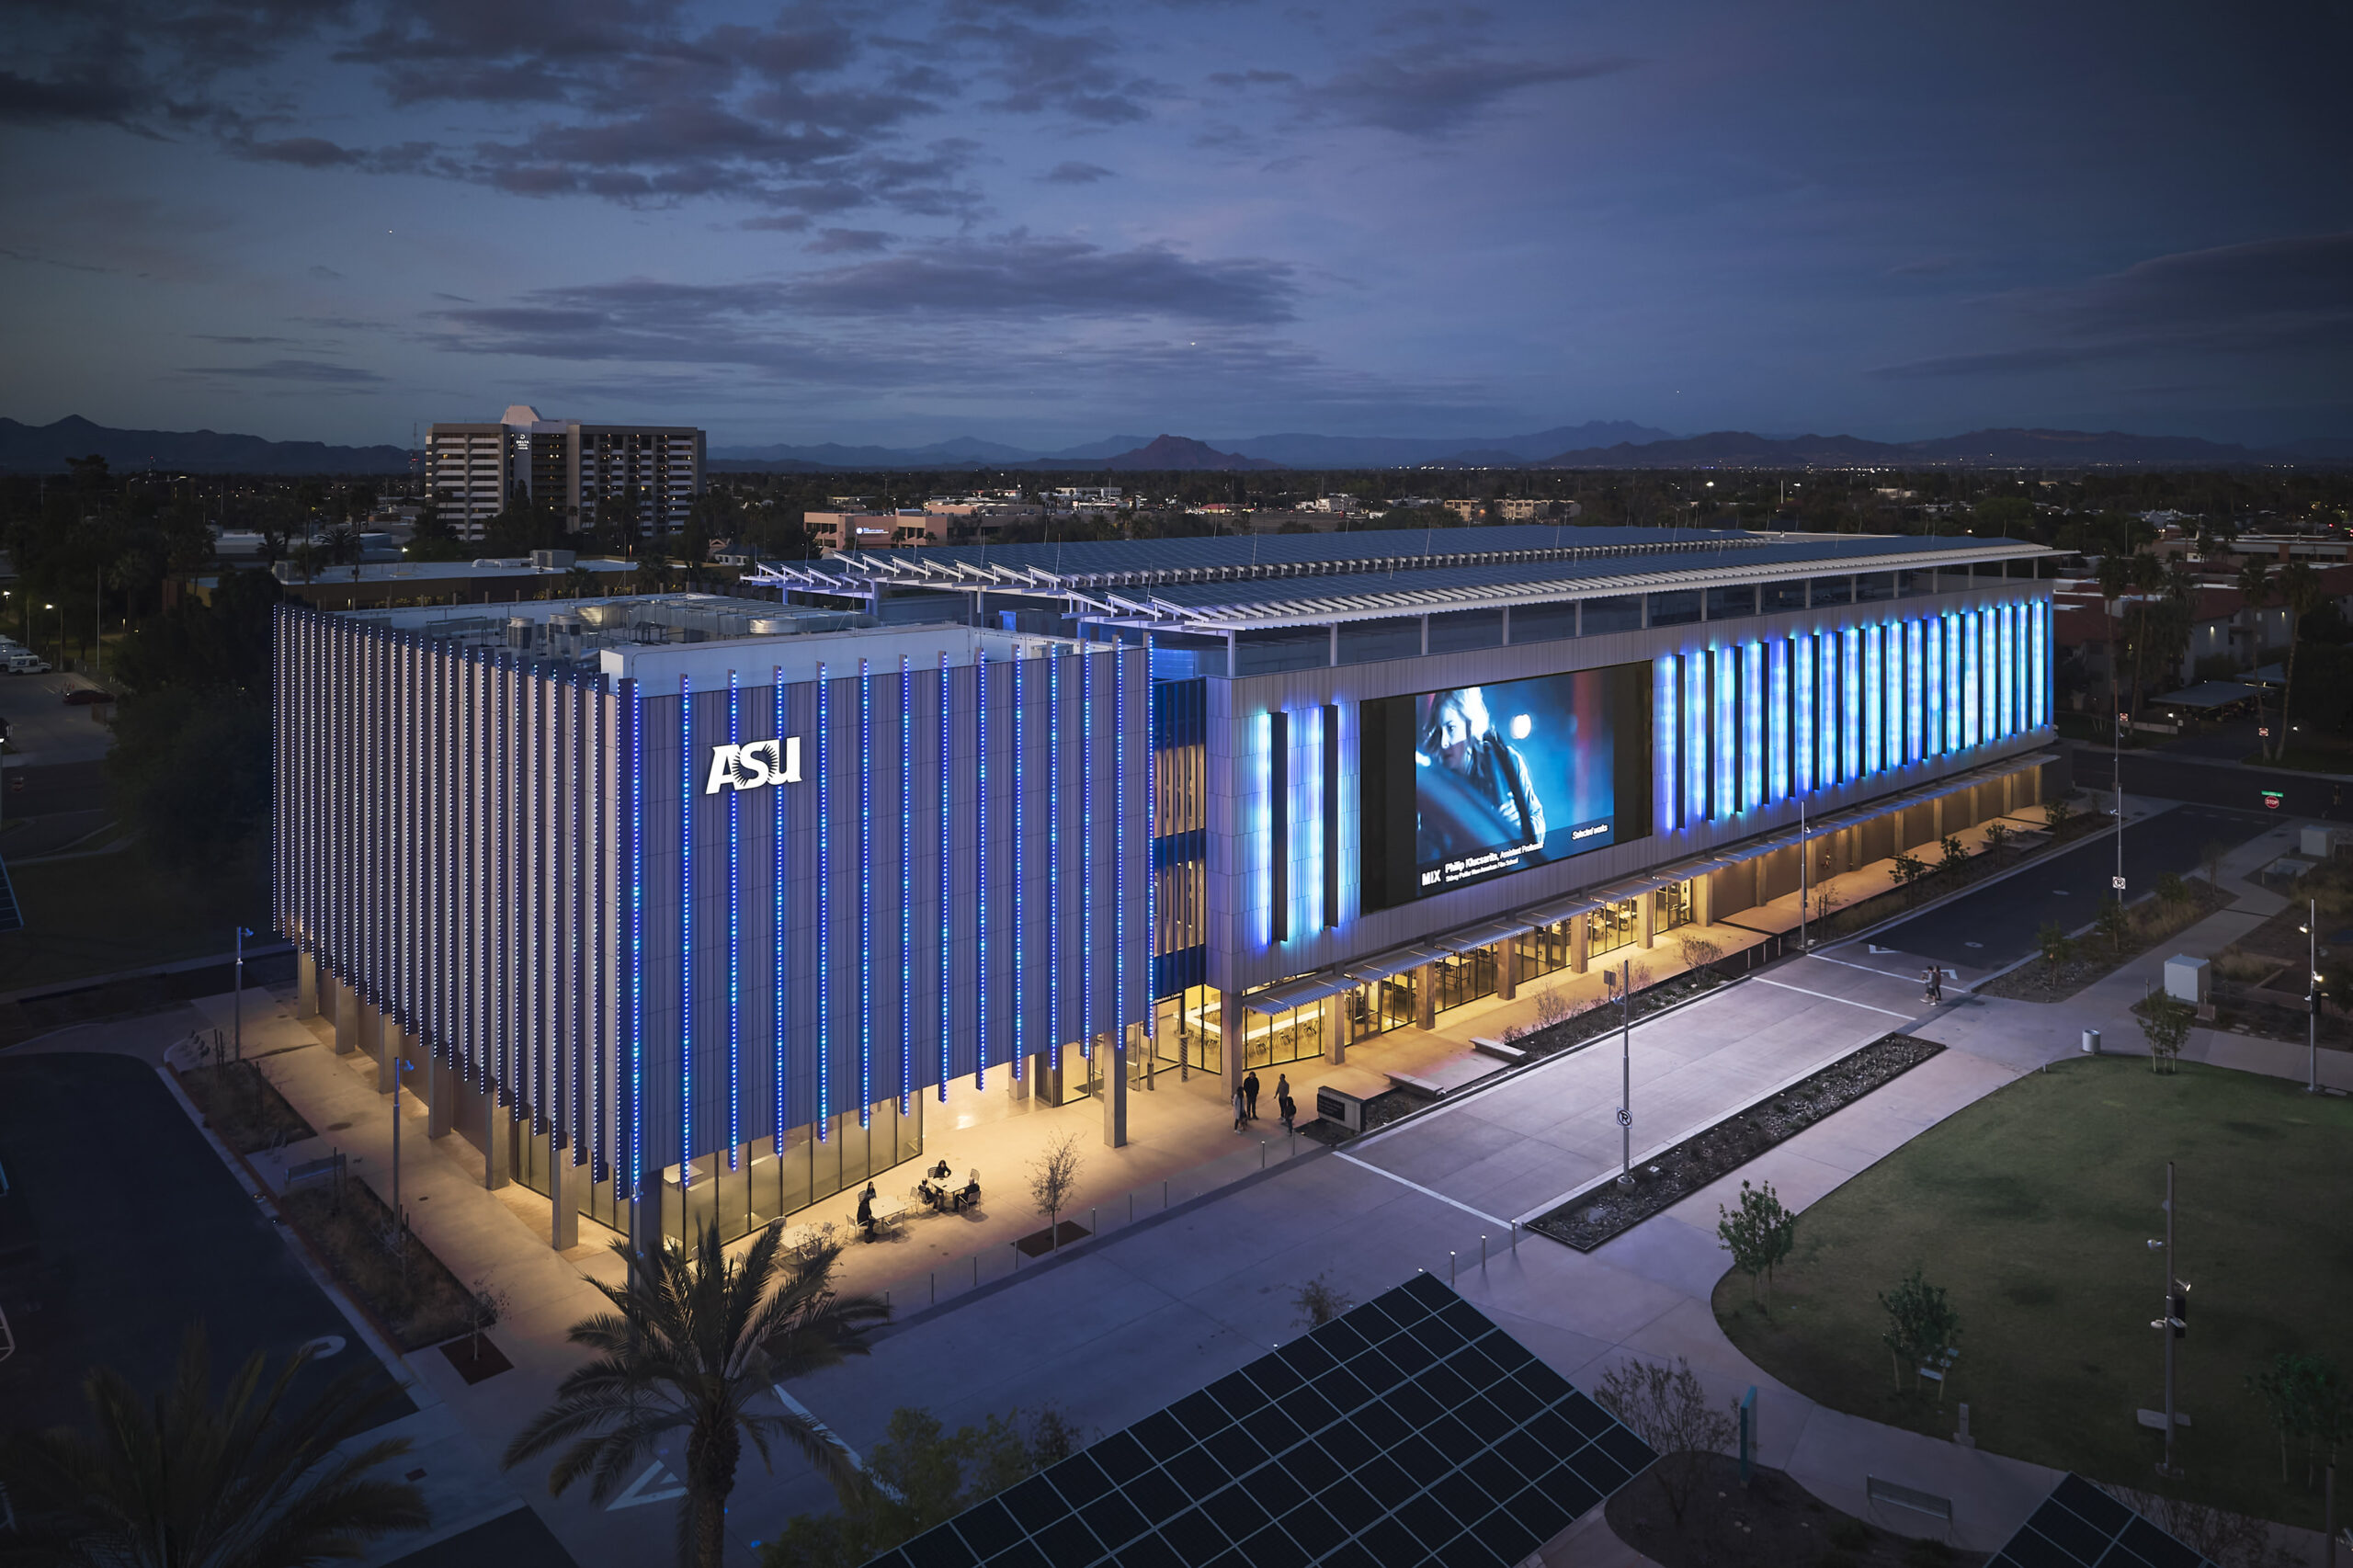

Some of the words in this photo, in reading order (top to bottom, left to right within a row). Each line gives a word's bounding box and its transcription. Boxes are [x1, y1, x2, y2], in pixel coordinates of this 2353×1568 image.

[705, 736, 802, 795] ASU
[1572, 826, 1594, 840] Selected
[1593, 824, 1608, 835] works
[1445, 861, 1465, 873] Philip
[1500, 846, 1522, 859] Assistant
[1521, 841, 1544, 853] Professor
[1422, 869, 1441, 886] MIX
